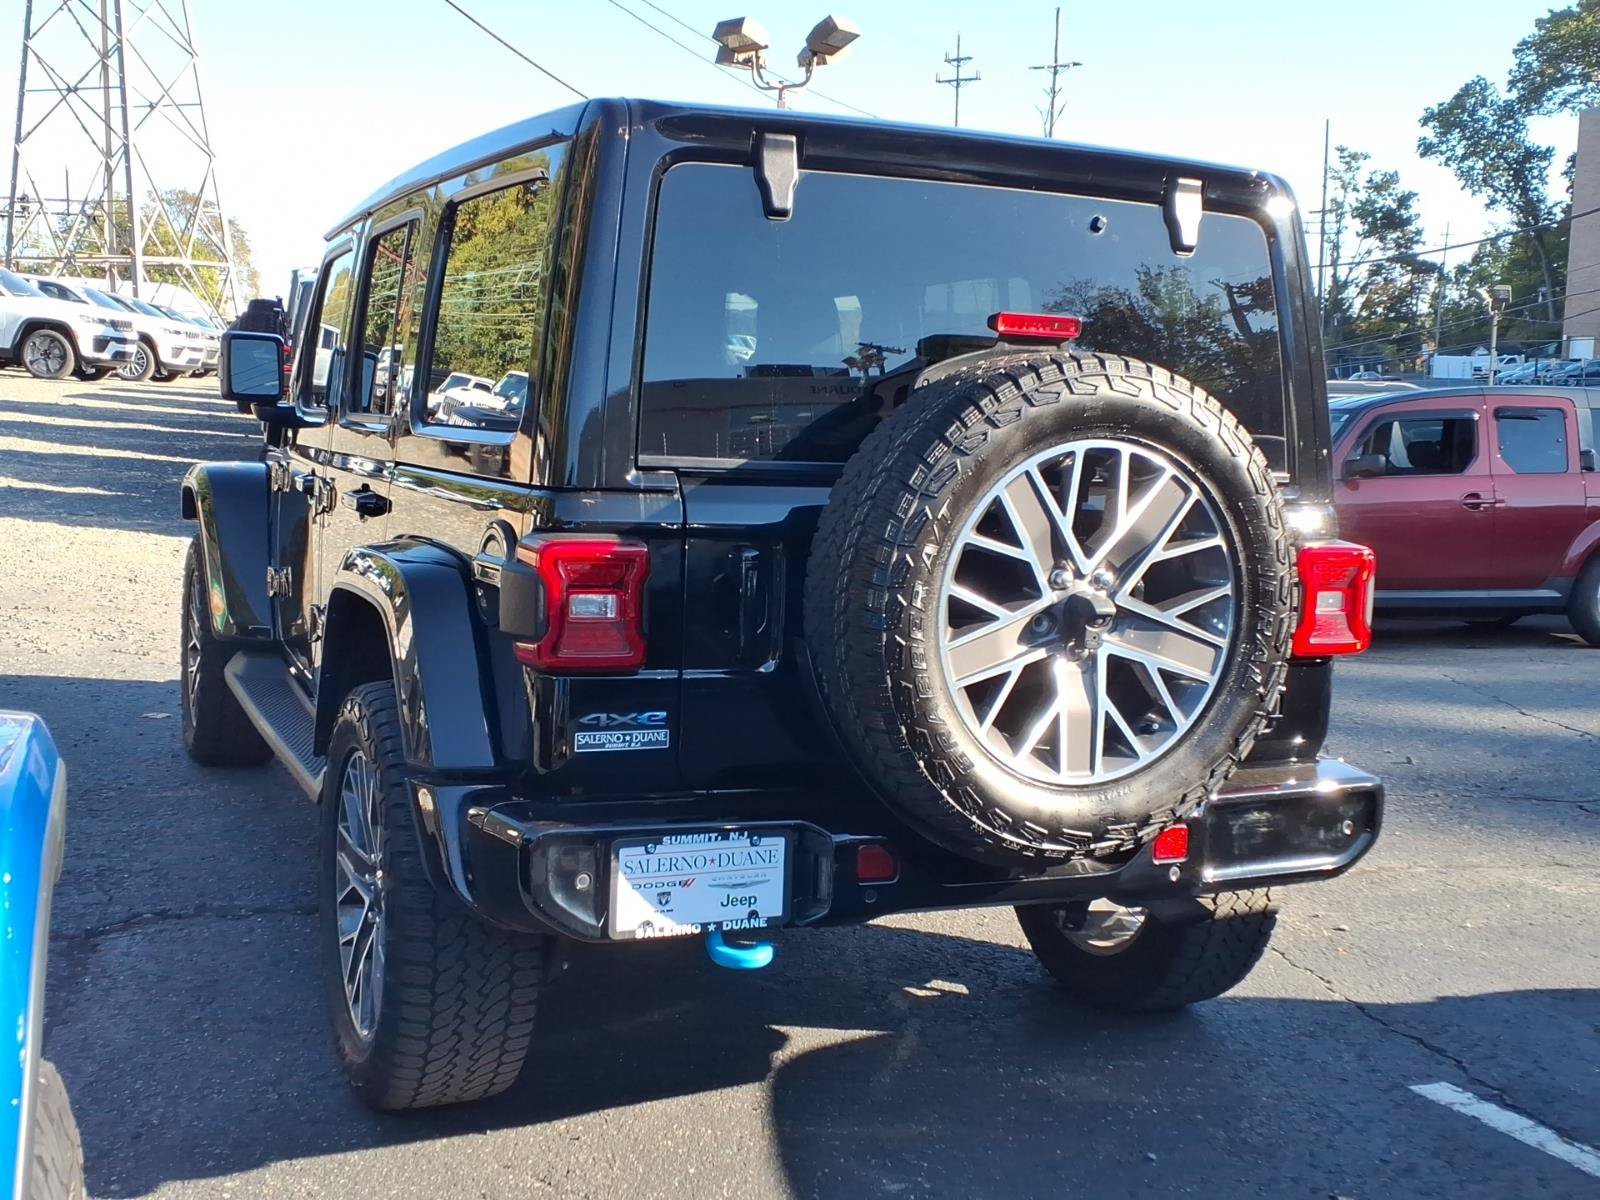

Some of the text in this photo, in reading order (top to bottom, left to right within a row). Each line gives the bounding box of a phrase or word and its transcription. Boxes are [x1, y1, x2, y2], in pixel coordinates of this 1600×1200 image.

[578, 731, 667, 745] SALERNO DUANE
[729, 830, 748, 842] NJ
[624, 849, 778, 875] SALERNO DUANE
[720, 893, 757, 908] Jeep
[722, 917, 767, 931] DUANE
